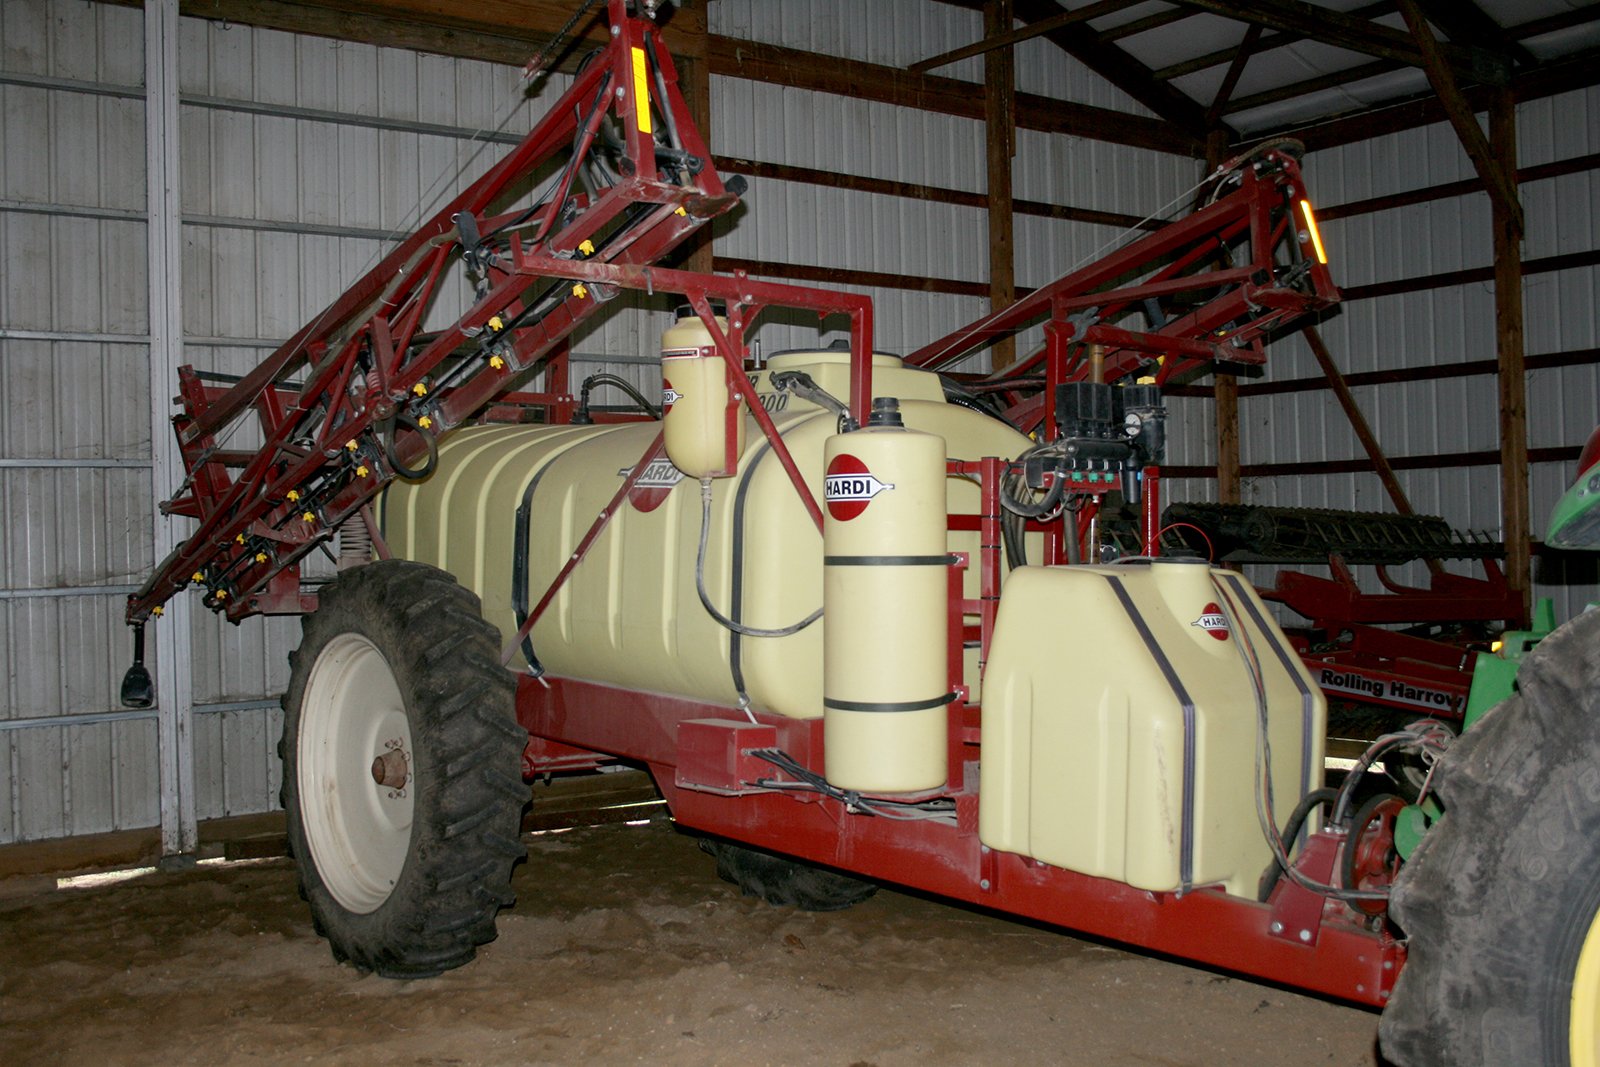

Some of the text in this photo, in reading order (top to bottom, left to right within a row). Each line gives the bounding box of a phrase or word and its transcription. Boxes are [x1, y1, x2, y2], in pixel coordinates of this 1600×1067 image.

[640, 464, 680, 480] ARDI
[826, 479, 871, 496] HARDI
[1202, 617, 1226, 627] HARD
[1320, 669, 1463, 709] Rolling Harrow
